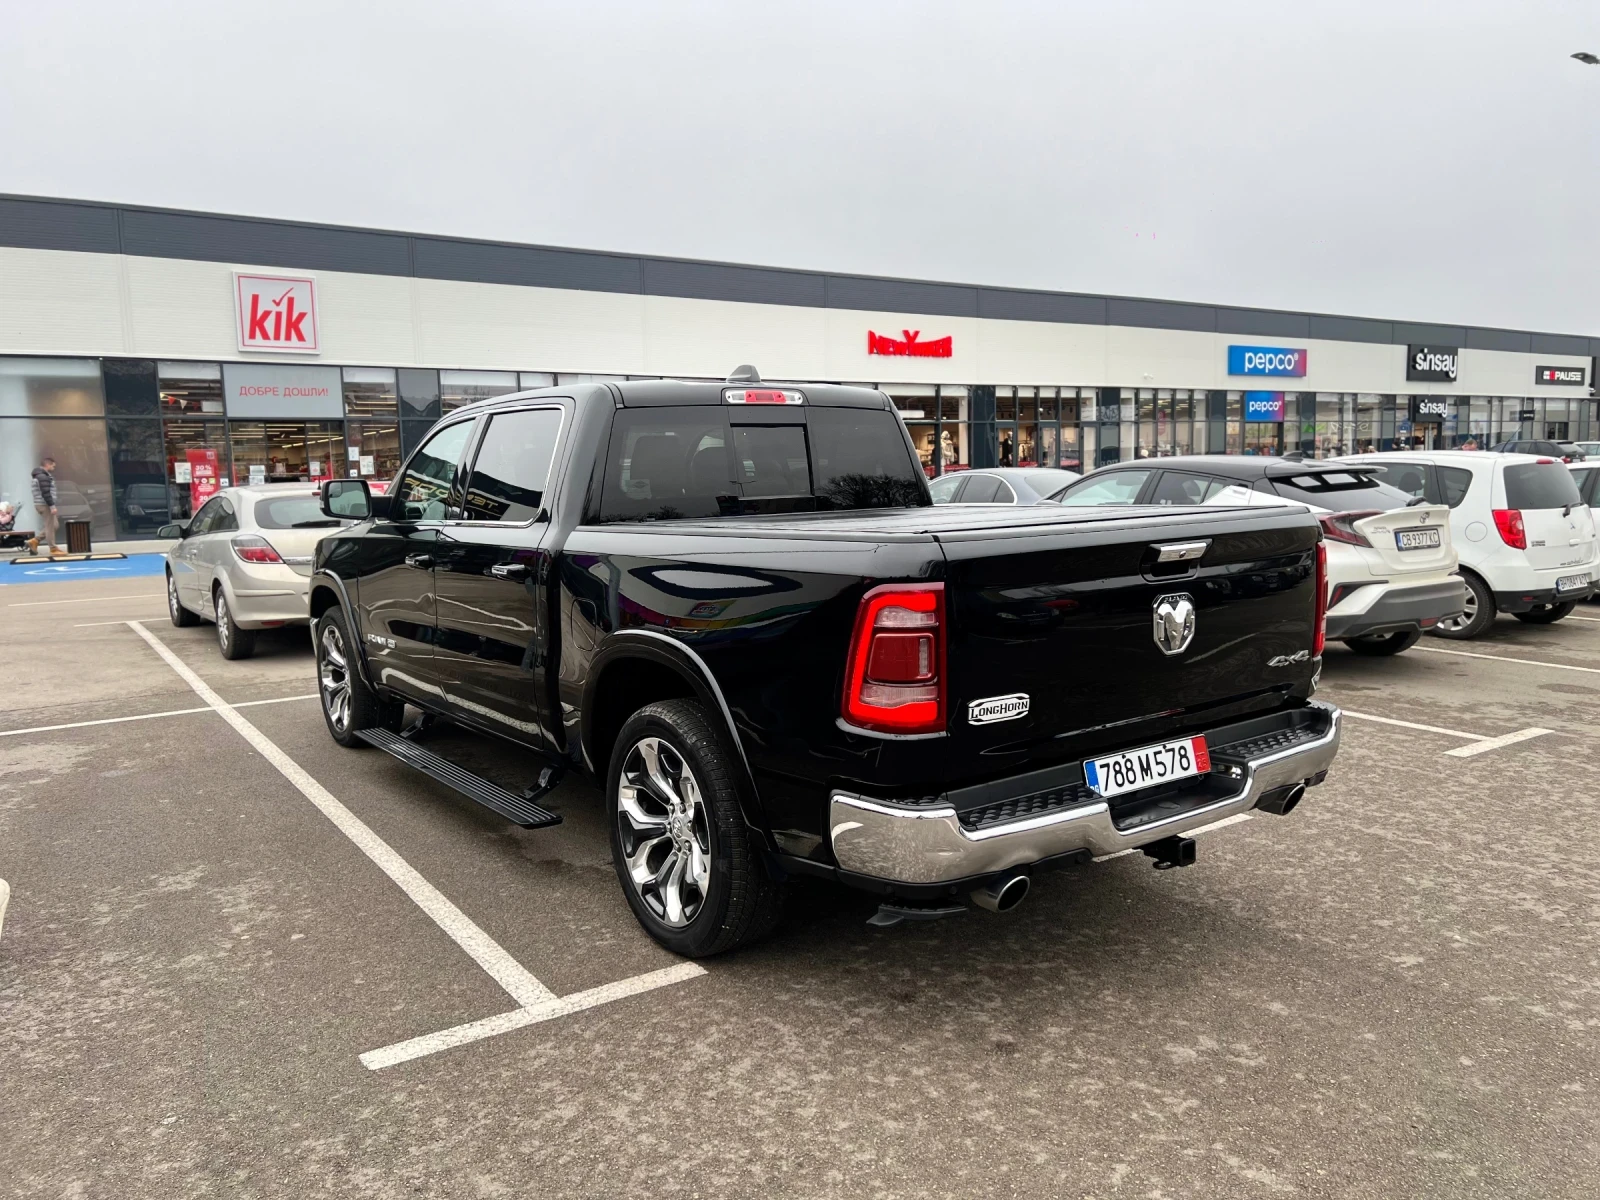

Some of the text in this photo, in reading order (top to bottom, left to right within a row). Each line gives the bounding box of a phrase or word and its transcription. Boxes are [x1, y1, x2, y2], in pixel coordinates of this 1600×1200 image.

[1416, 348, 1457, 378] sinsay
[239, 386, 329, 398] ДОБРЕ ДОШЛИ!
[1420, 399, 1448, 418] sinsay
